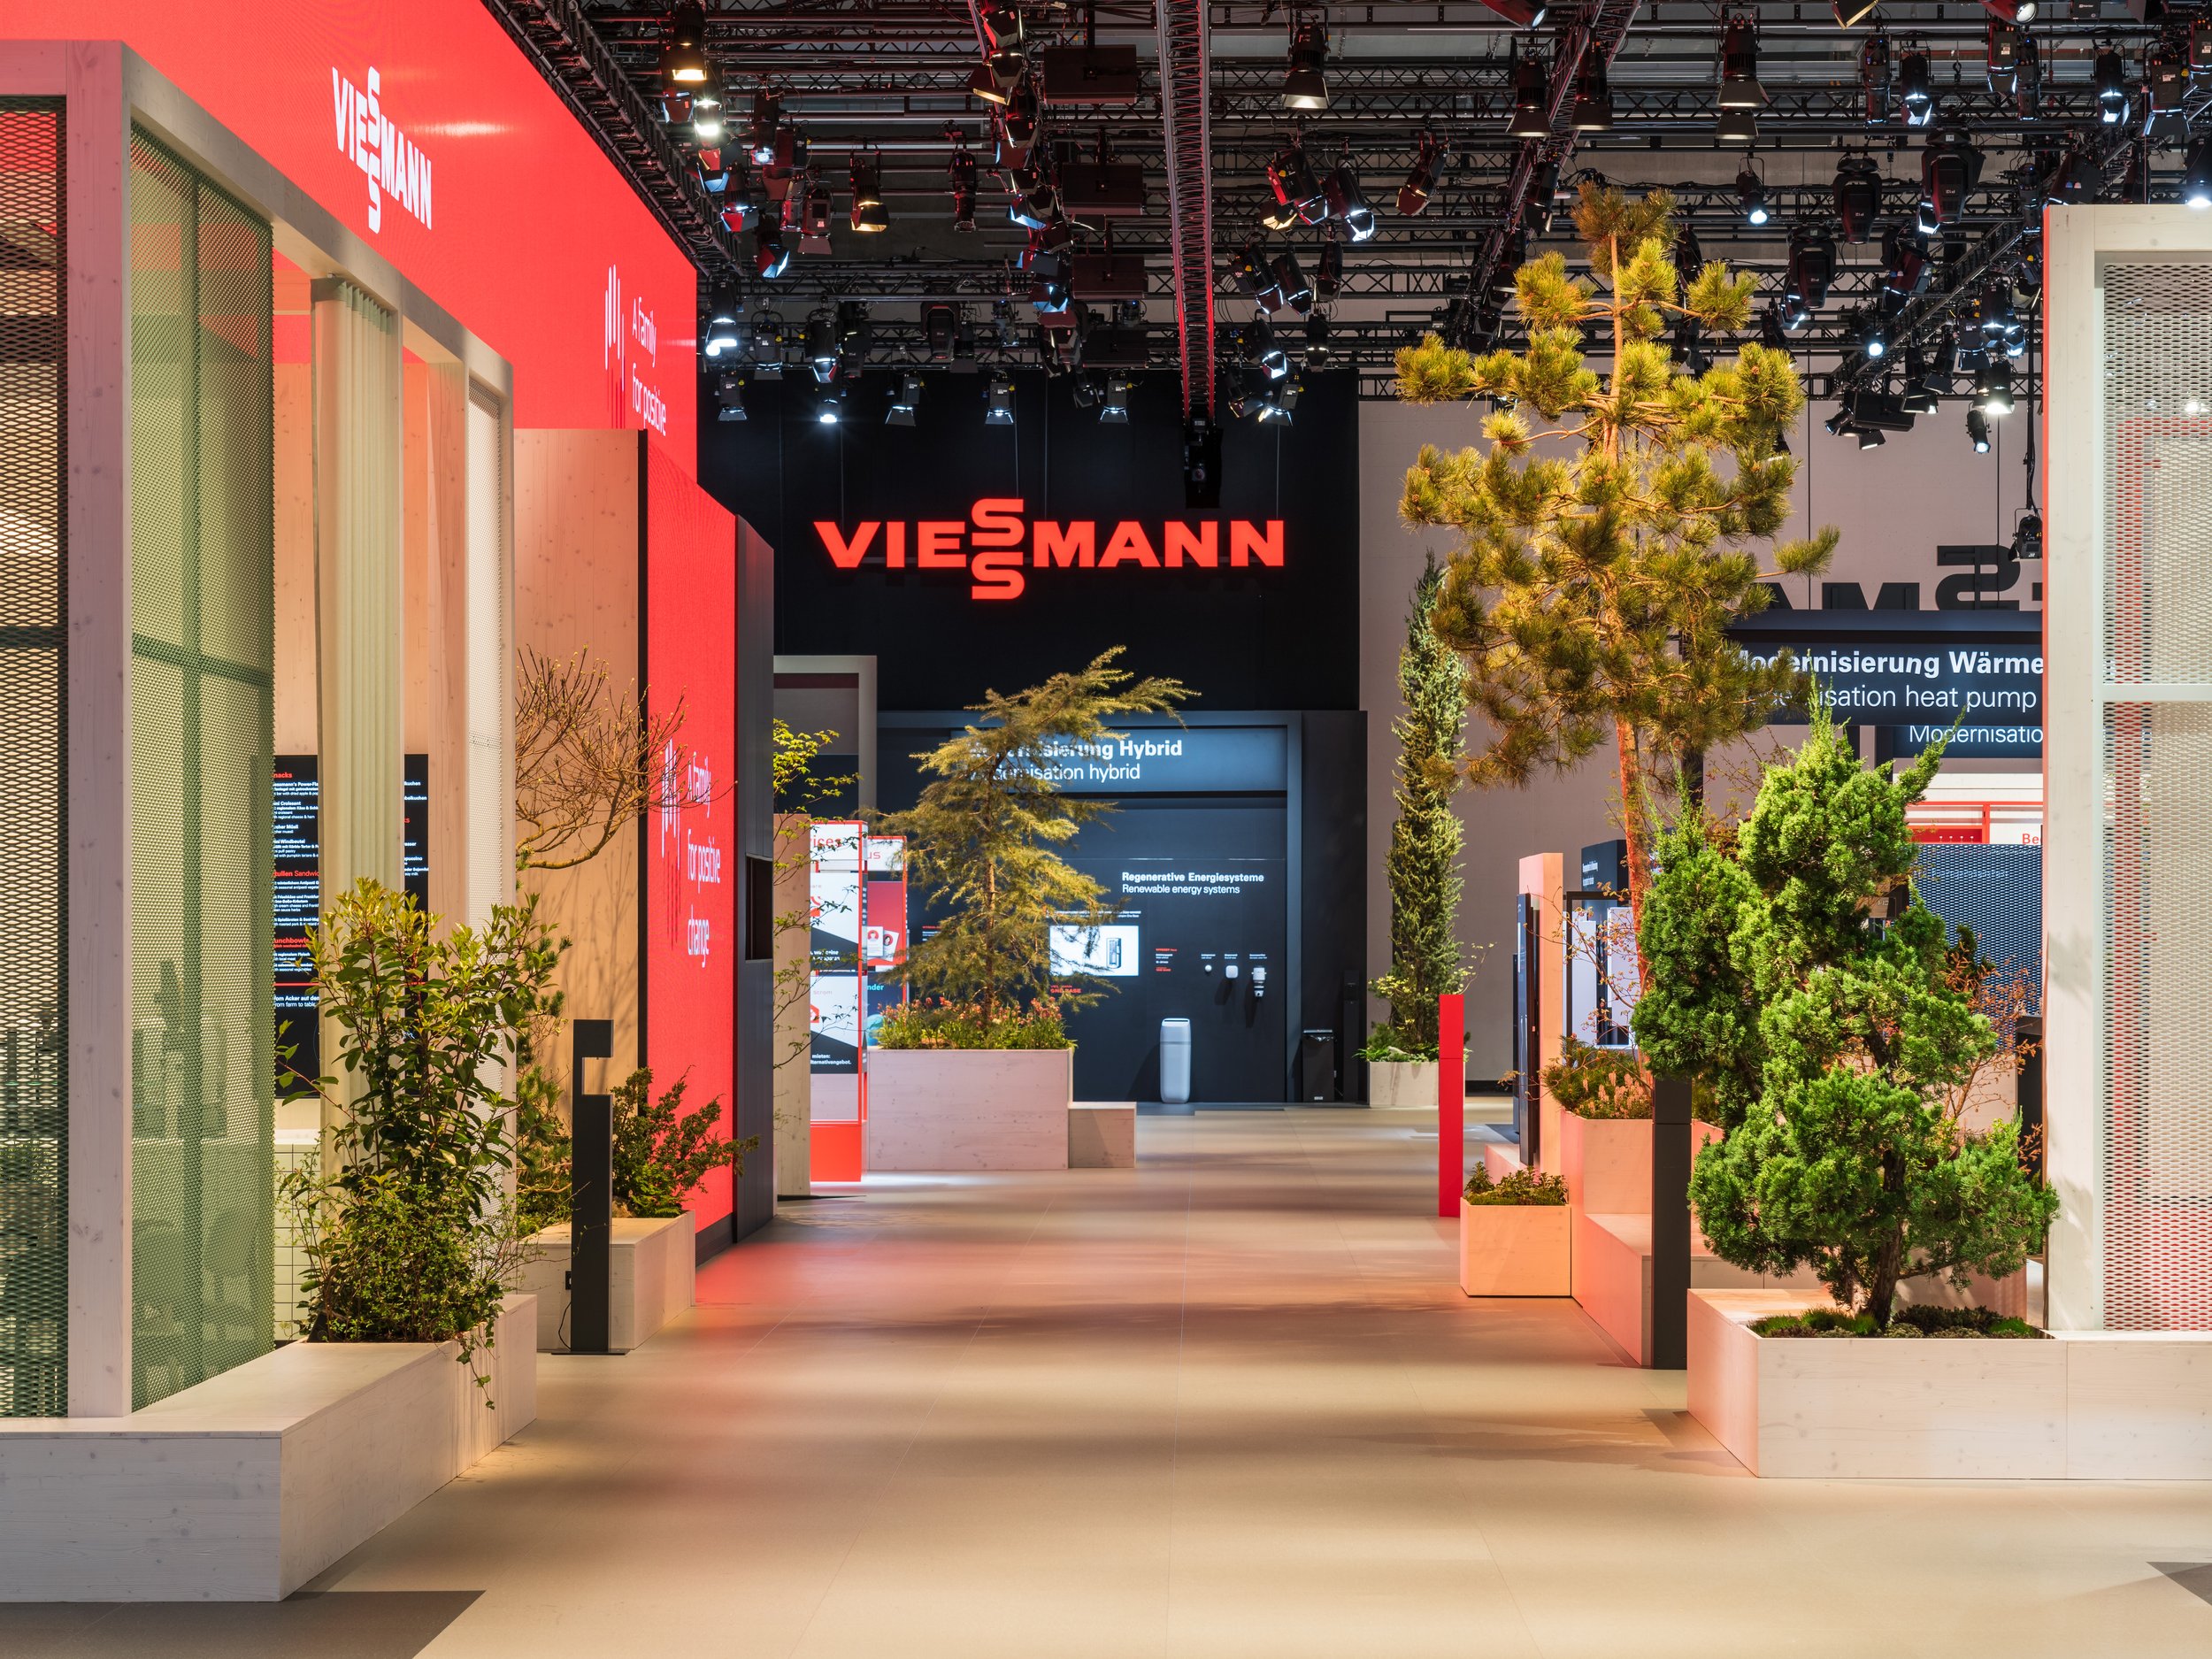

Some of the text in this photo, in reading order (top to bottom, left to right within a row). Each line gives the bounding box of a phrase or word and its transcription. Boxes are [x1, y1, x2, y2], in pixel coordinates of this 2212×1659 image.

[333, 65, 432, 234] VIESSMANN
[632, 296, 657, 369] A family
[632, 362, 666, 437] for positive
[813, 498, 1285, 600] VIESSMANN
[1906, 684, 1959, 707] heat
[1966, 689, 2037, 713] pump
[1089, 764, 1141, 783] hybrid
[1119, 740, 1182, 761] Hybrid
[687, 829, 721, 895] for positive
[1122, 872, 1264, 884] Regenerative Energiesysteme
[1122, 884, 1240, 895] Renewable energy systems
[687, 904, 710, 968] change
